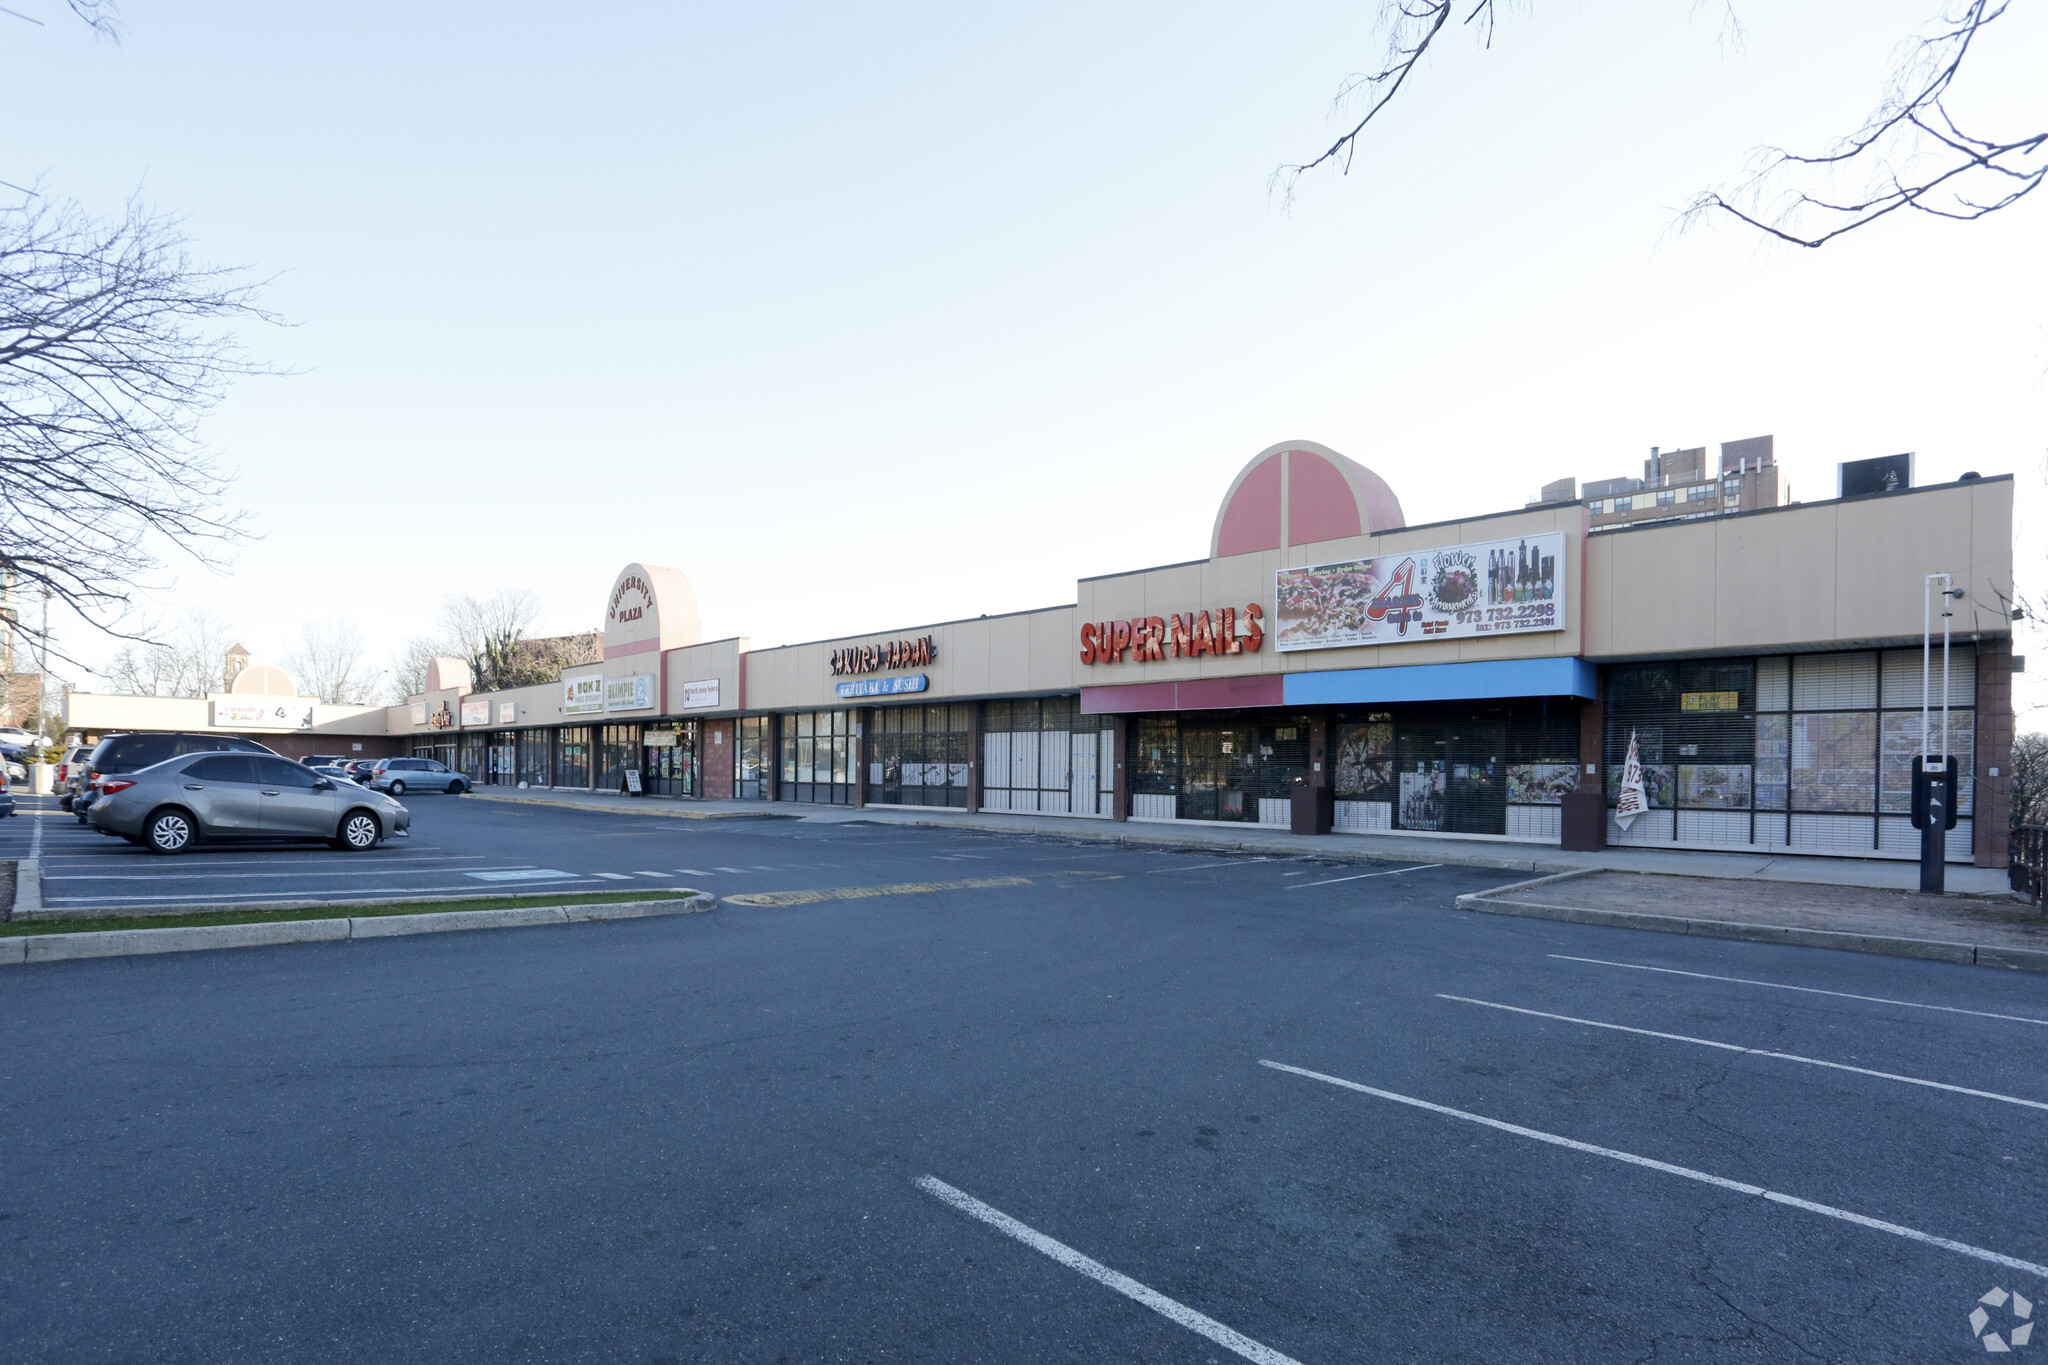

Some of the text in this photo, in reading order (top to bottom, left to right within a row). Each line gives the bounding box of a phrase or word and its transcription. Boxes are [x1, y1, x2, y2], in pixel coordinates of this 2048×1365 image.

[1432, 550, 1477, 572] Flower
[1308, 568, 1331, 577] Catering
[1336, 565, 1353, 573] Order
[610, 576, 653, 619] UNIVERSITY
[619, 606, 643, 623] PLAZA
[1456, 609, 1483, 625] 973
[1080, 603, 1263, 666] SUPER NAILS
[1494, 621, 1511, 631] 973
[829, 634, 932, 676] SAKURA JAPAN
[607, 681, 634, 699] BLIMPIE
[840, 677, 920, 696] TERIYAKI & SUSHI
[1699, 701, 1720, 709] HERE
